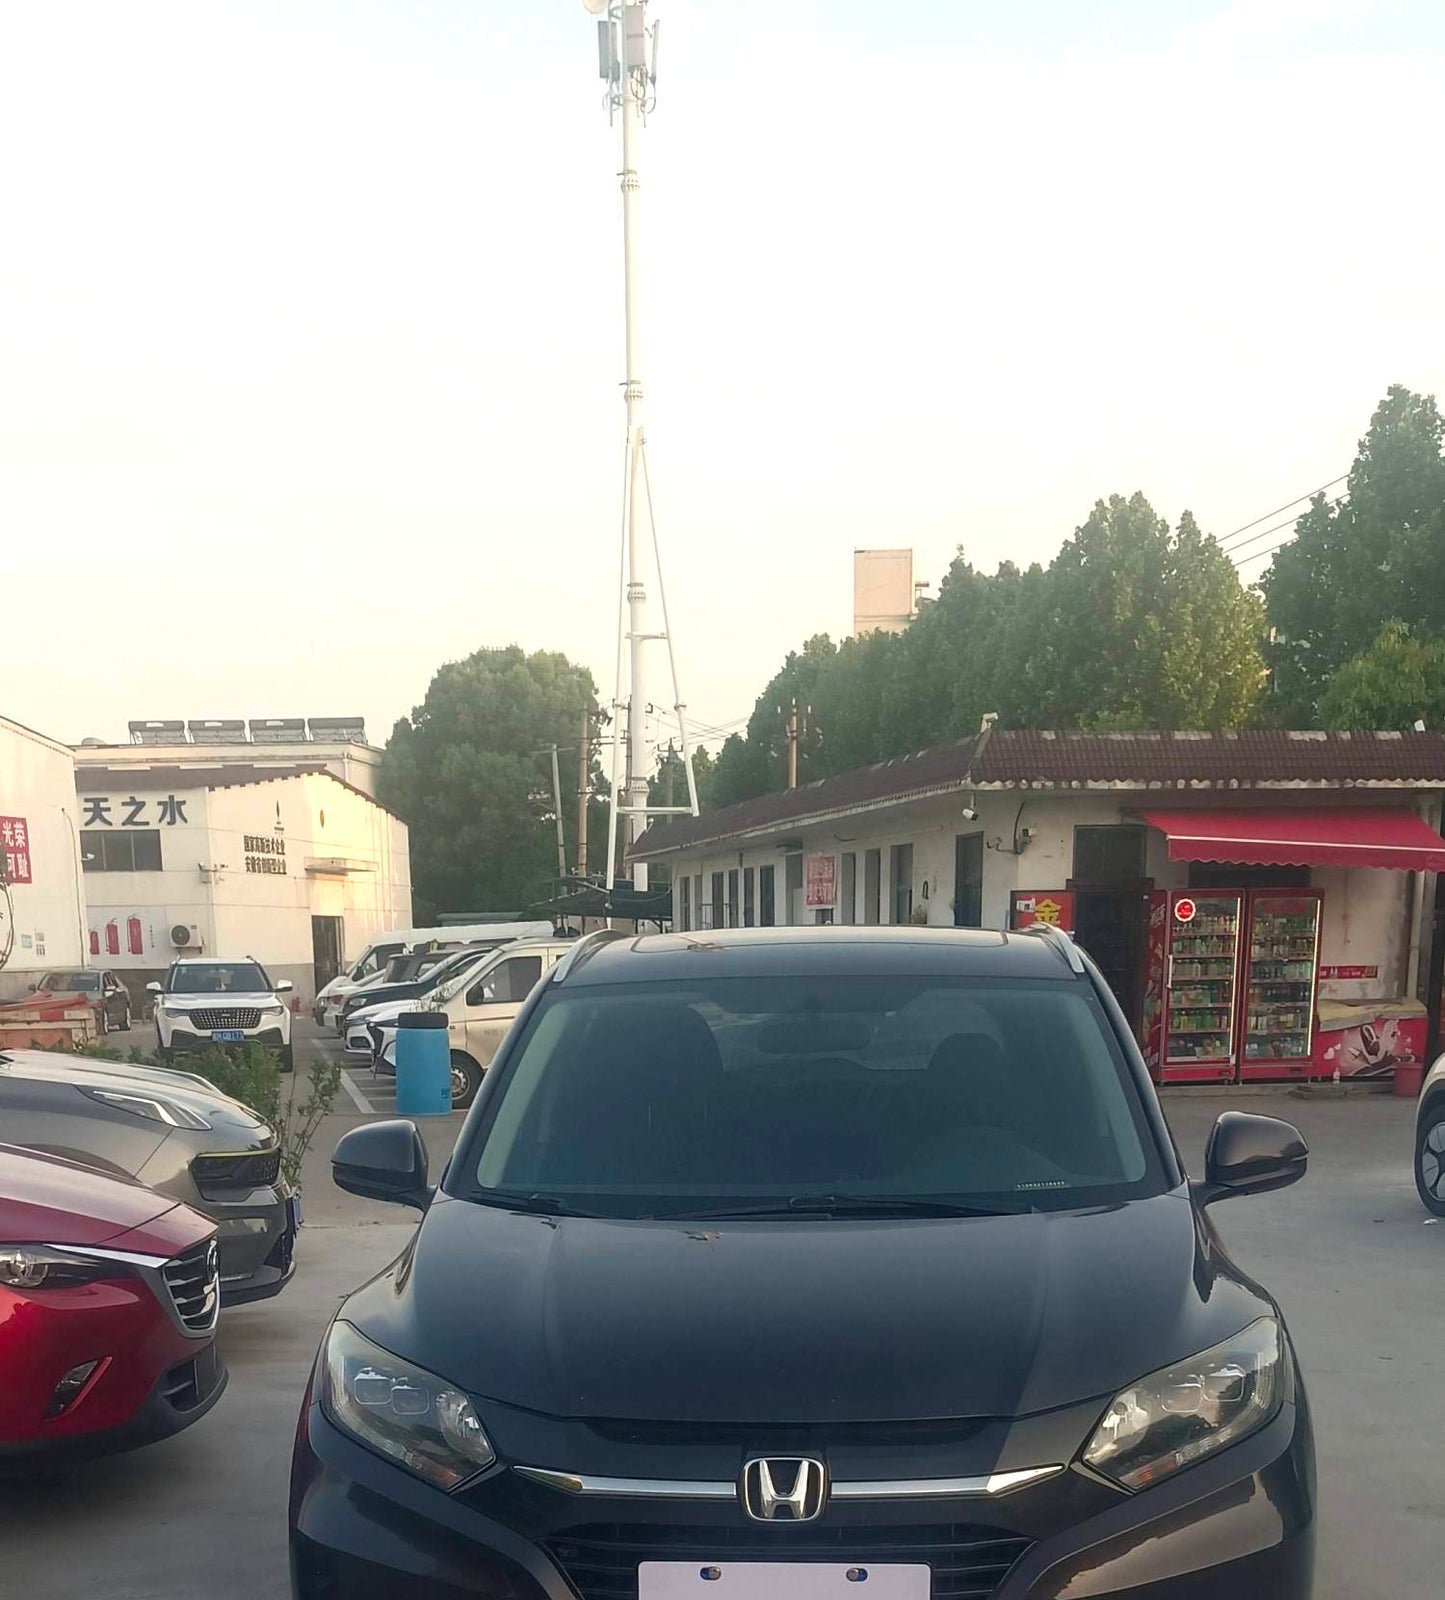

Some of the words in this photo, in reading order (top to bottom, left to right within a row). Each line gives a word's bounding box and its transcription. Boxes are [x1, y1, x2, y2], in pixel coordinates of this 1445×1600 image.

[83, 795, 187, 826] 天之水
[2, 820, 26, 848] 光荣
[1034, 898, 1061, 926] 金
